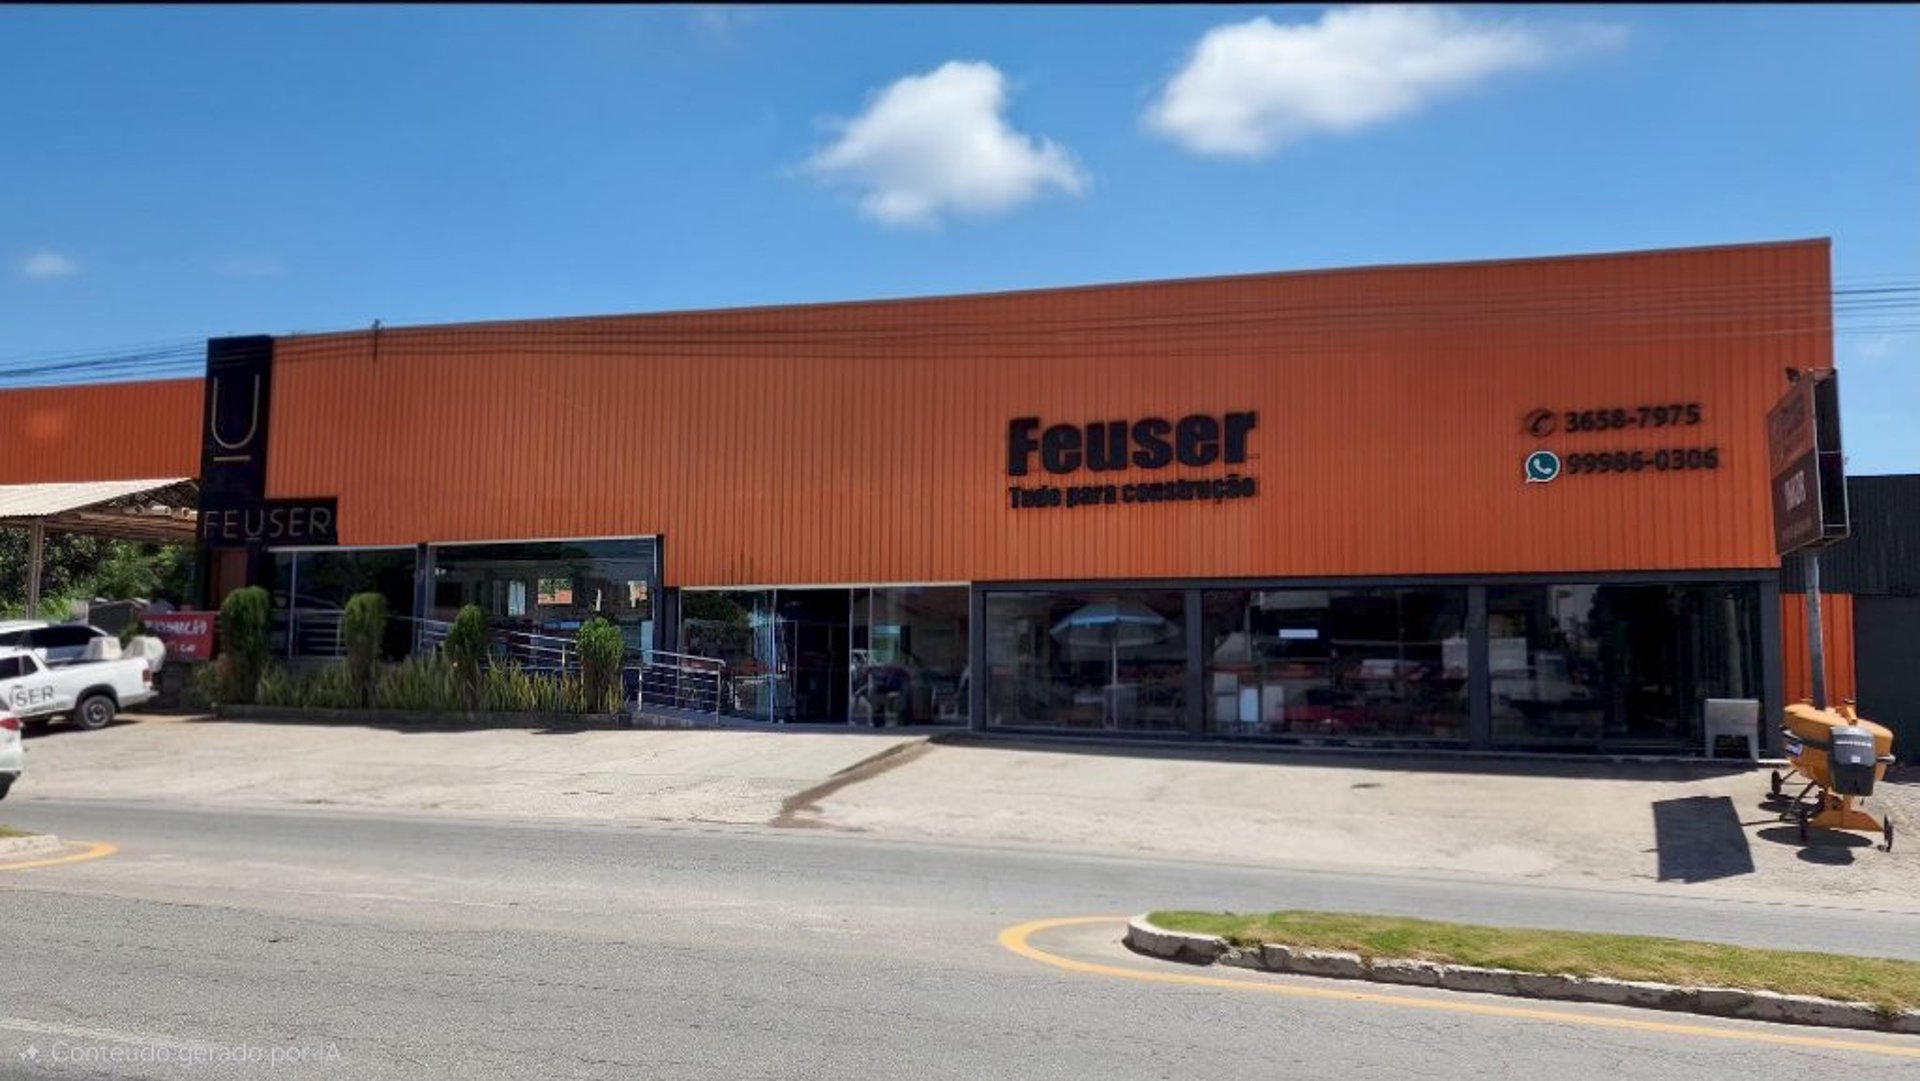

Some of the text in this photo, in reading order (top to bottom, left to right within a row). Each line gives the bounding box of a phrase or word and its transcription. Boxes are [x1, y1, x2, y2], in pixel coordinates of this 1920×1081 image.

[1564, 404, 1701, 433] 3658-7975
[1008, 411, 1257, 476] Feuser
[1566, 448, 1720, 475] 99986-0306
[1009, 474, 1255, 509] Tudo para construção
[203, 507, 332, 541] FEUSER
